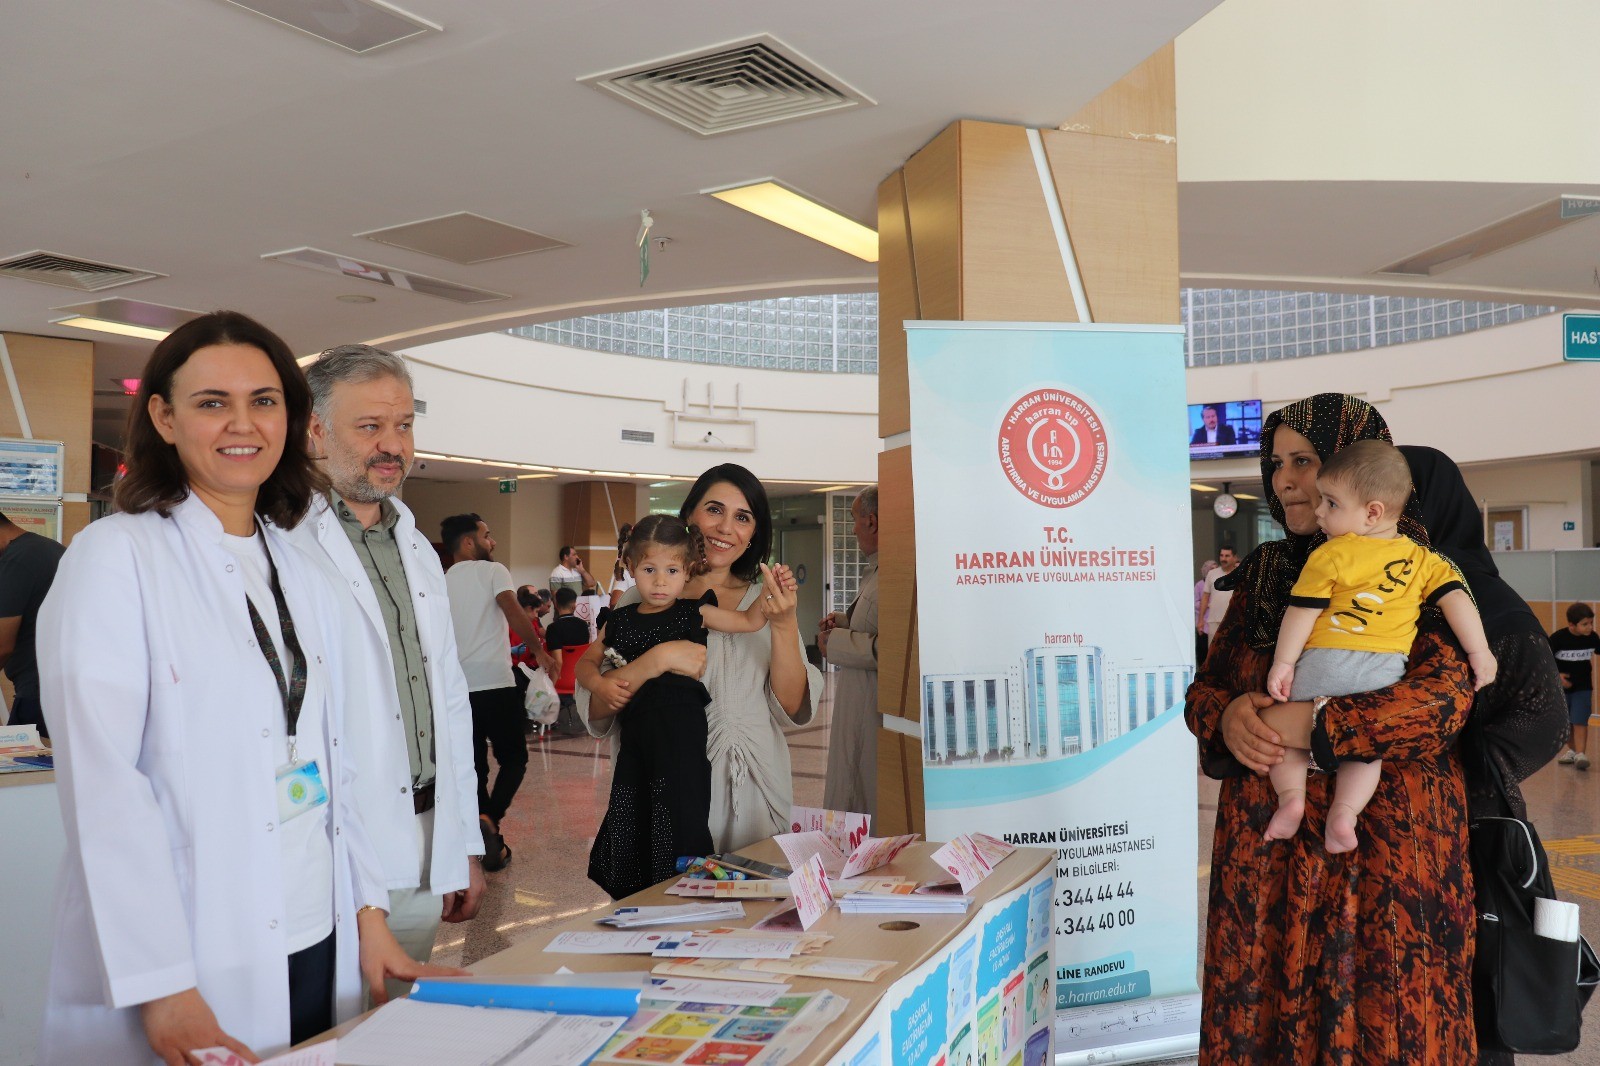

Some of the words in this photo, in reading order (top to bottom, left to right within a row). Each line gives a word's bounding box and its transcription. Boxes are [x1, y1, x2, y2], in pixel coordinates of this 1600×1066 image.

[1008, 393, 1041, 425] HARRAN
[1043, 392, 1101, 432] ÜNİVERSİTESİ
[1025, 407, 1061, 425] harran
[1001, 436, 1027, 491] ARAŞTIRMA
[1027, 487, 1040, 499] VE
[1040, 489, 1085, 505] UYGULAMA
[1082, 441, 1105, 492] HASTANESİ
[1043, 526, 1074, 544] T.C.
[955, 550, 1035, 570] HARRAN
[1040, 546, 1155, 568] ÜNİVERSİTESİ
[956, 573, 1024, 586] ARAŞTIRMA
[1026, 572, 1040, 583] VE
[1042, 571, 1096, 583] UYGULAMA
[1097, 569, 1156, 582] HASTANESİ
[1044, 632, 1072, 644] harran
[1073, 632, 1083, 647] tıp
[1003, 831, 1056, 845] HARRAN
[1059, 821, 1129, 842] ÜNİVERSİTESİ
[1106, 836, 1155, 855] HASTANESİ
[1072, 859, 1120, 877] BİLGİLERİ:
[1062, 888, 1093, 907] 344
[1097, 884, 1113, 902] 44
[1117, 880, 1134, 898] 44
[1064, 916, 1095, 935] 344
[1099, 912, 1114, 930] 40
[1119, 908, 1135, 926] 00
[1084, 960, 1125, 978] RANDEVU
